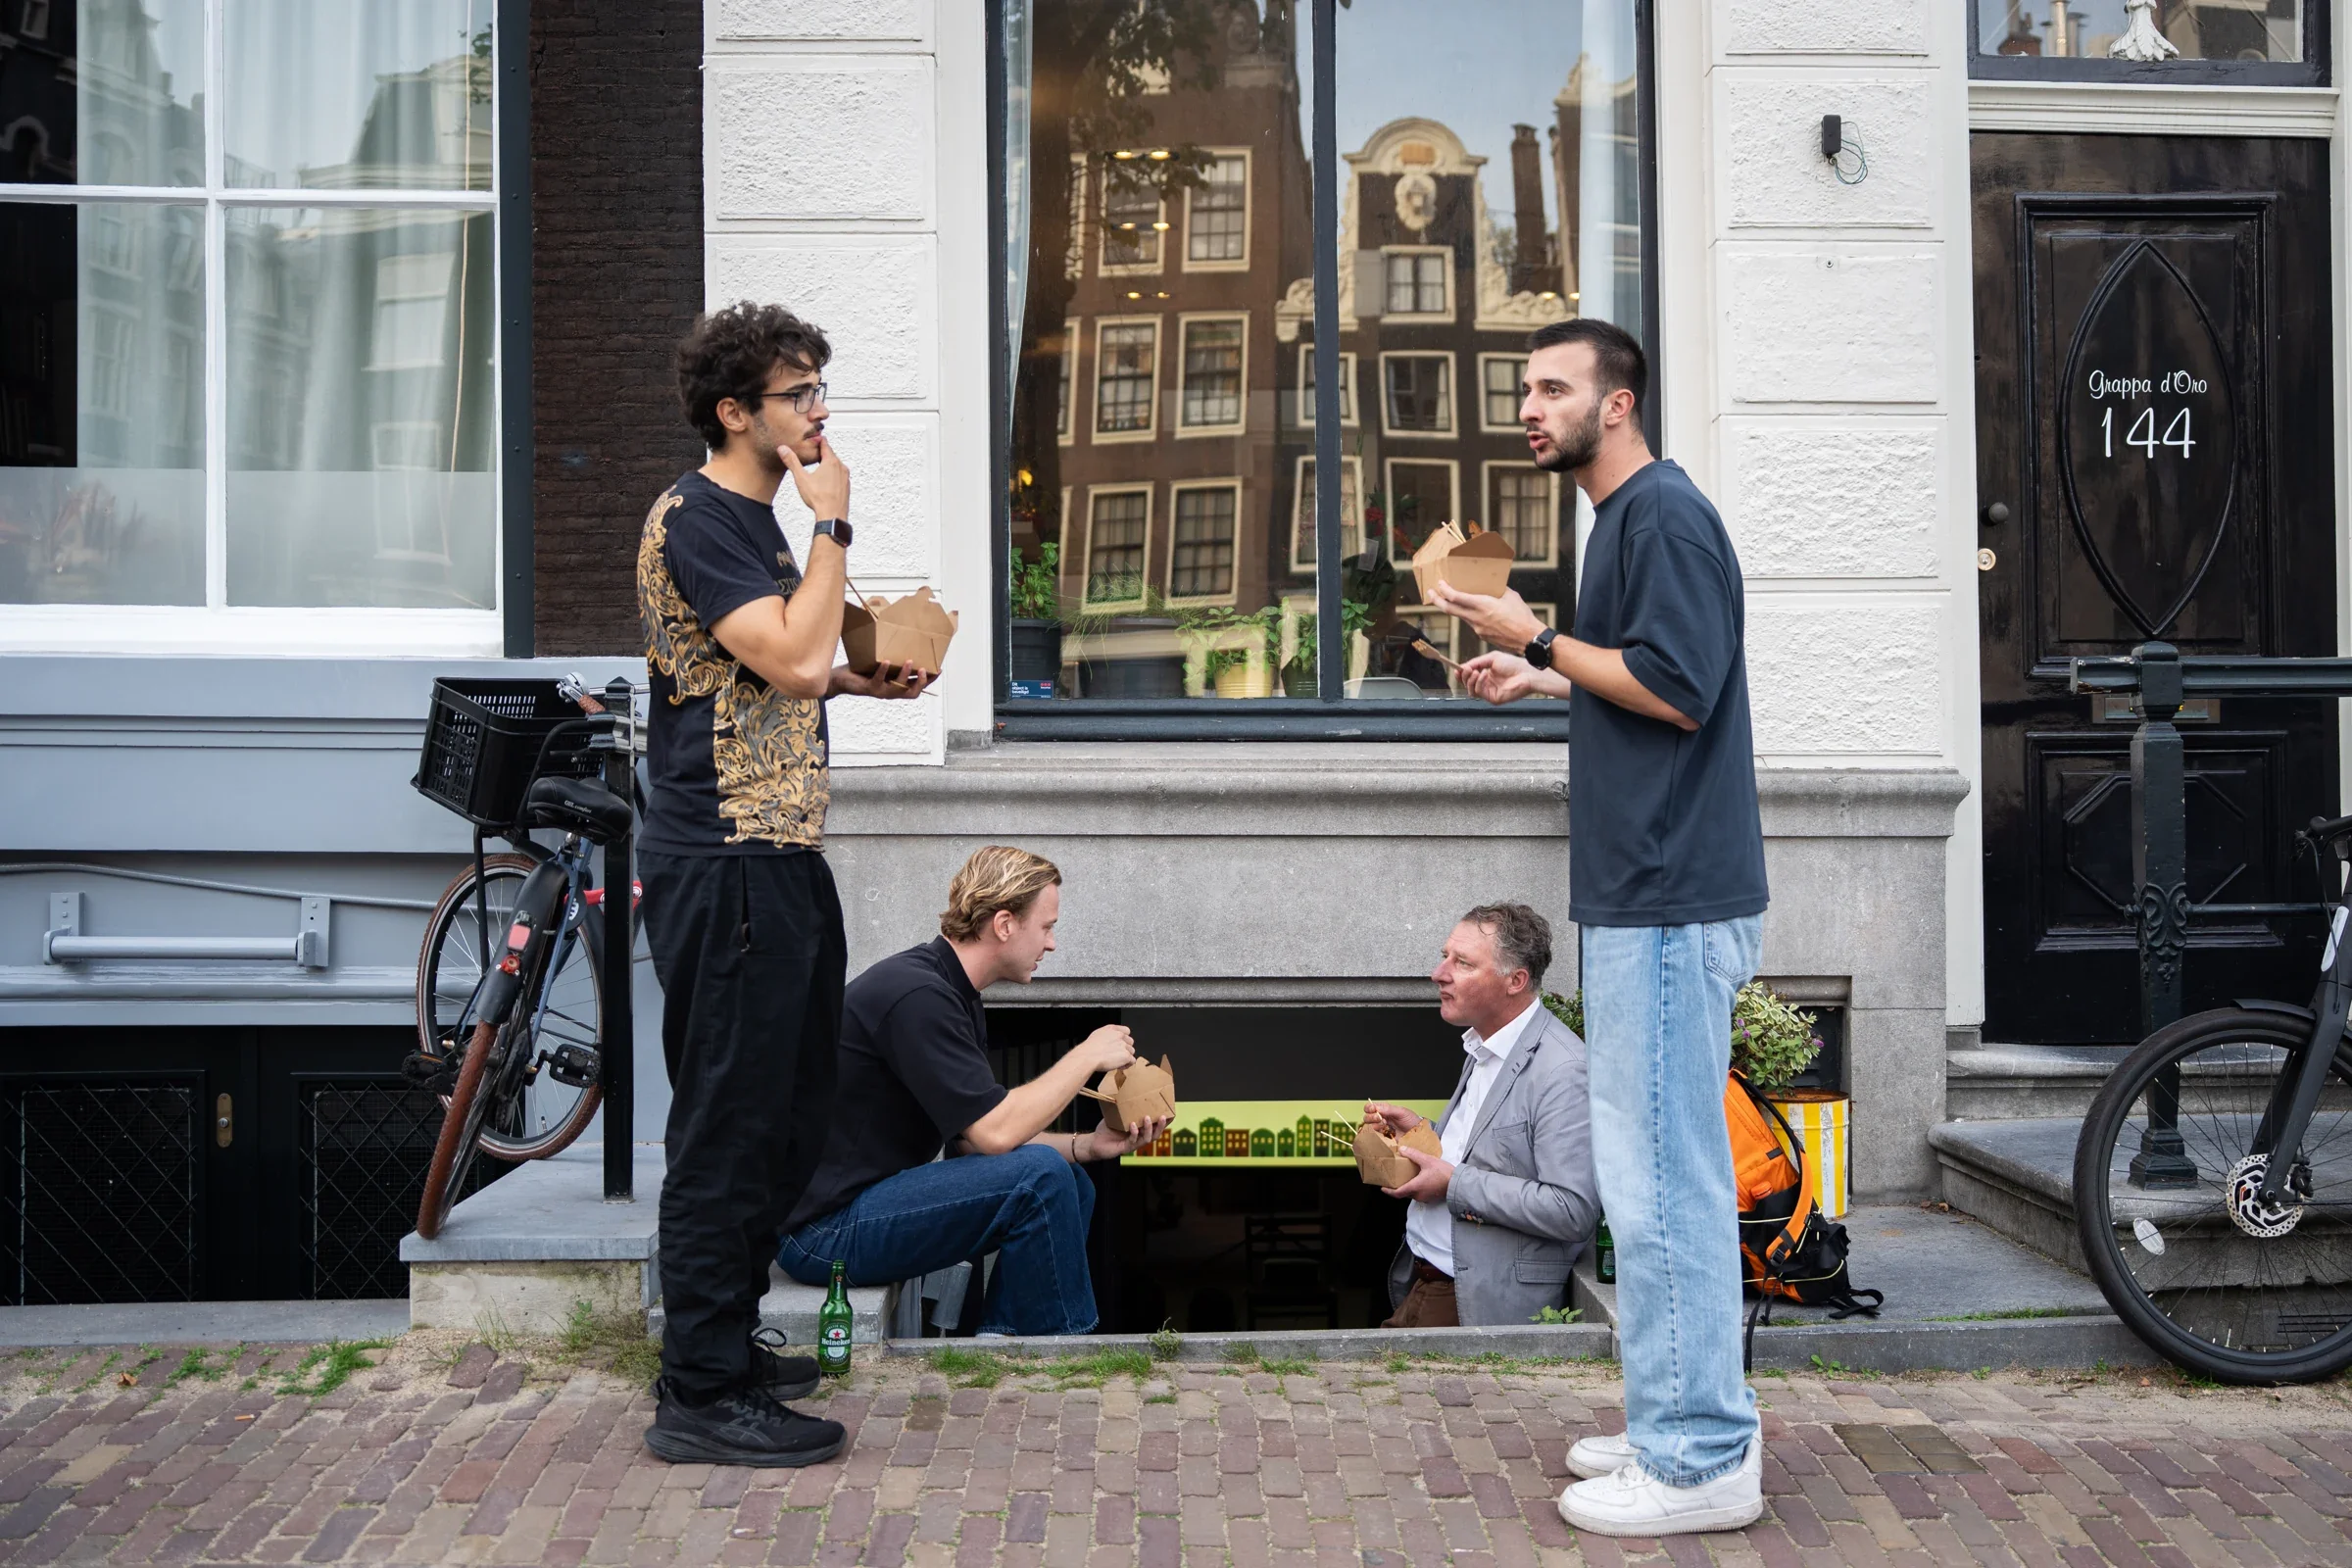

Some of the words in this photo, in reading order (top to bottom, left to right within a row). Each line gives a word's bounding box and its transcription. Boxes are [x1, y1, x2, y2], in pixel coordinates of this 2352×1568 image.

[2088, 369, 2152, 400] Grappa
[2160, 369, 2208, 394] d'Oro
[2101, 407, 2196, 459] 144
[821, 1337, 851, 1347] Heineken
